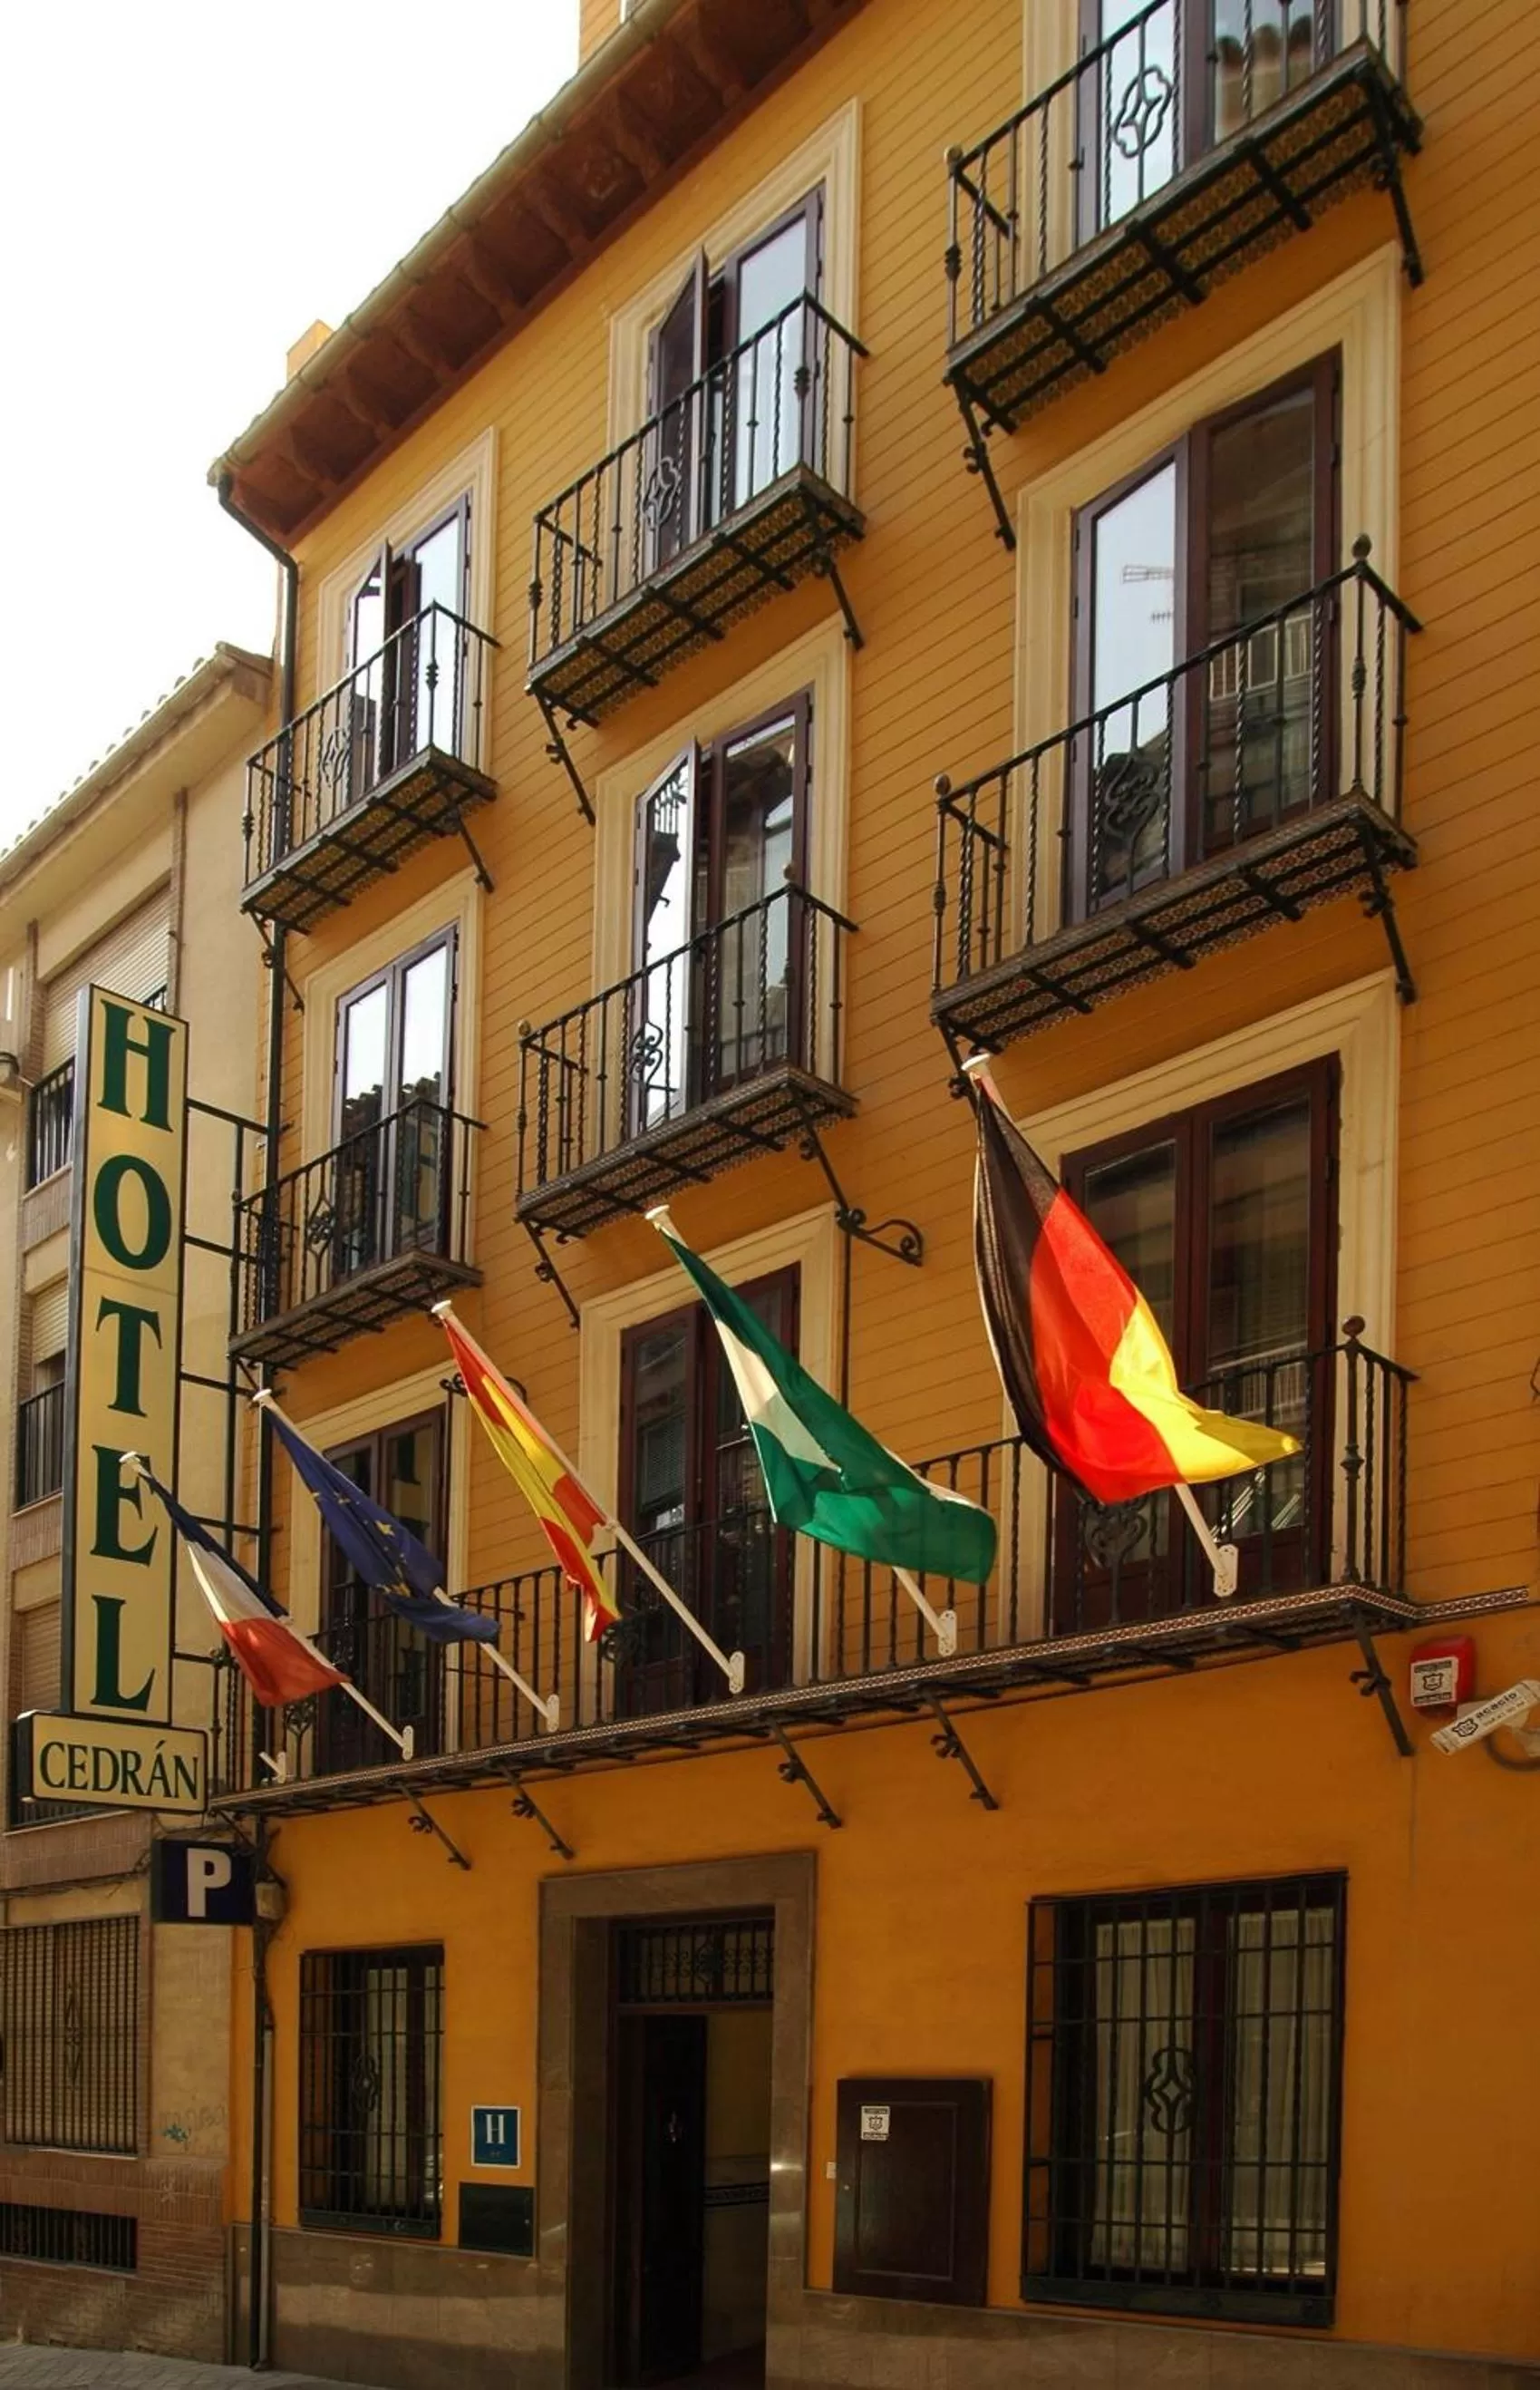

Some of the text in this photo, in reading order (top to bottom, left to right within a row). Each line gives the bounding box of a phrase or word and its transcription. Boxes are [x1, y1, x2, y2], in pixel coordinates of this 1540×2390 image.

[90, 999, 177, 1711] HOTEL
[40, 1740, 199, 1800] CEDRÁN
[187, 1848, 232, 1918] P
[485, 2113, 506, 2145] H
